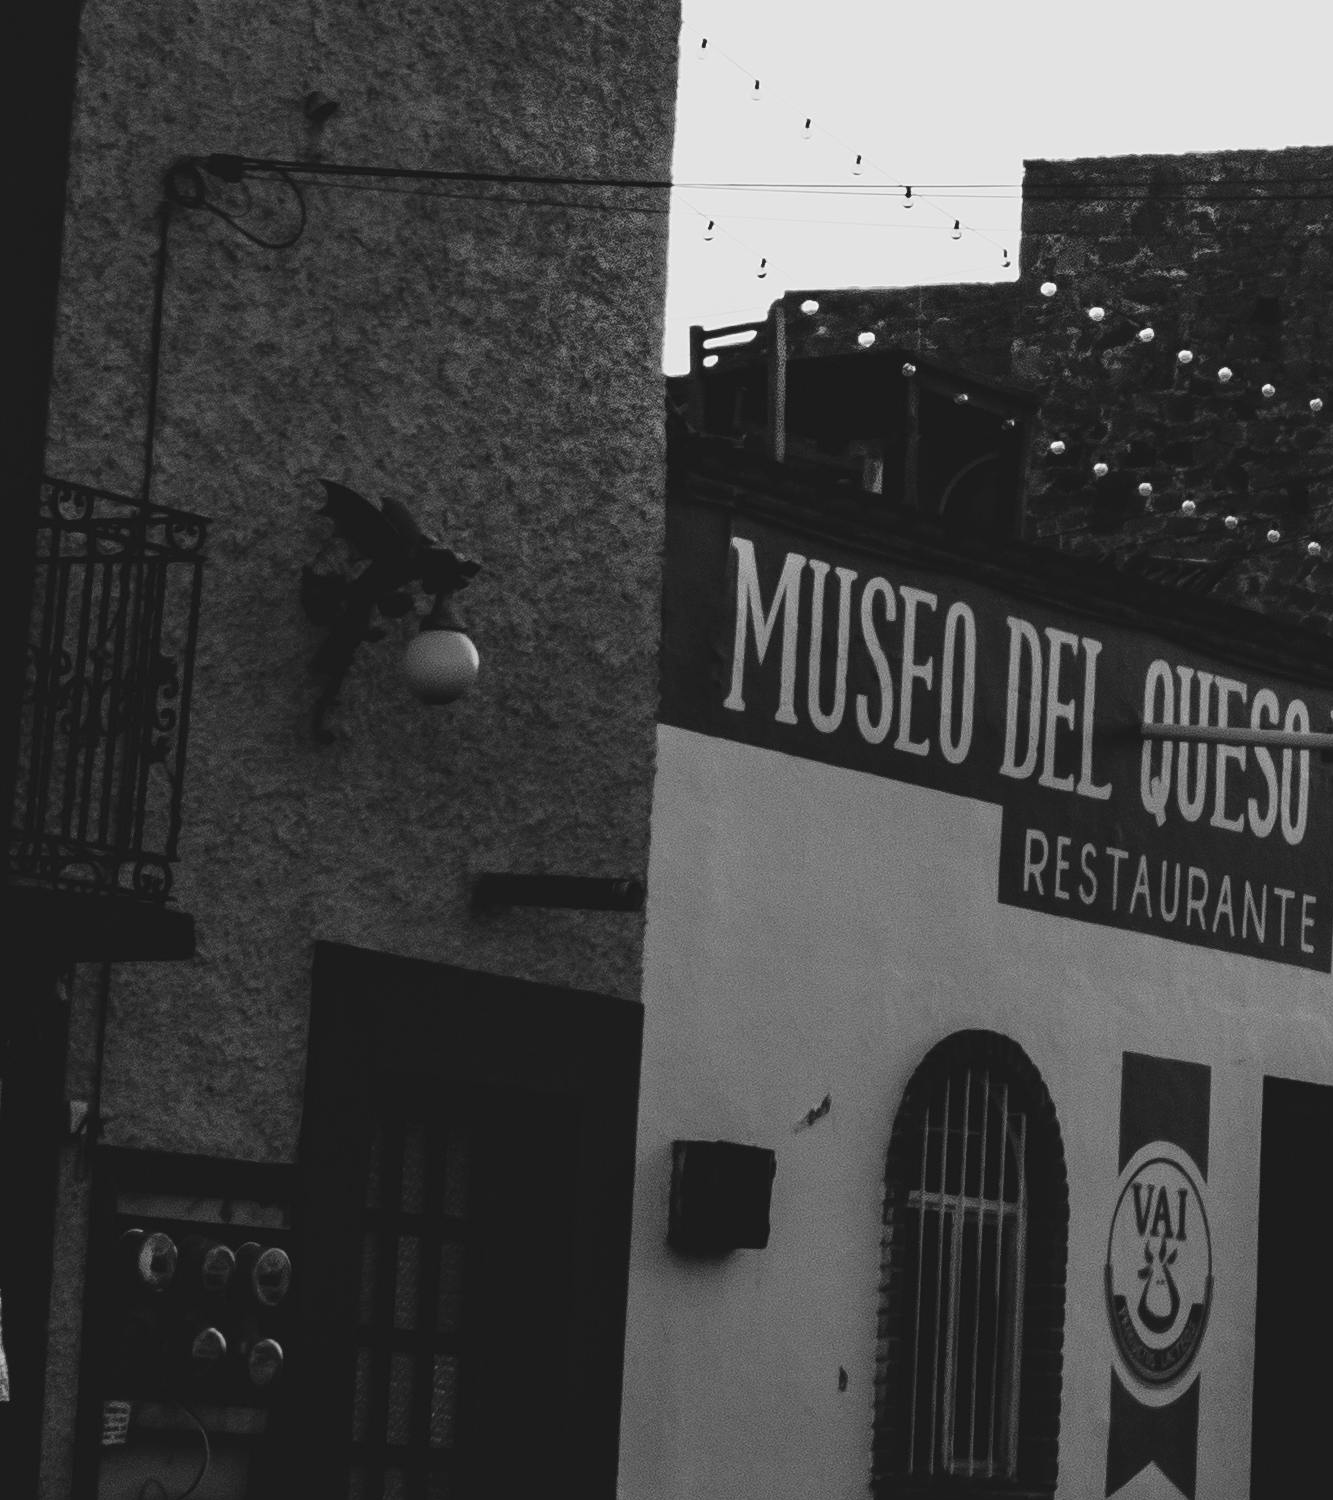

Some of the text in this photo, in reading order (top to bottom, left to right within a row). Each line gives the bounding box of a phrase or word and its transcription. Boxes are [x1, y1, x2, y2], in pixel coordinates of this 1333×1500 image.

[722, 534, 977, 767] MUSEO
[997, 613, 1112, 801] DEL
[1140, 659, 1311, 846] QUESO
[1023, 829, 1317, 954] RESTAURANTE
[1131, 1181, 1188, 1242] VAI
